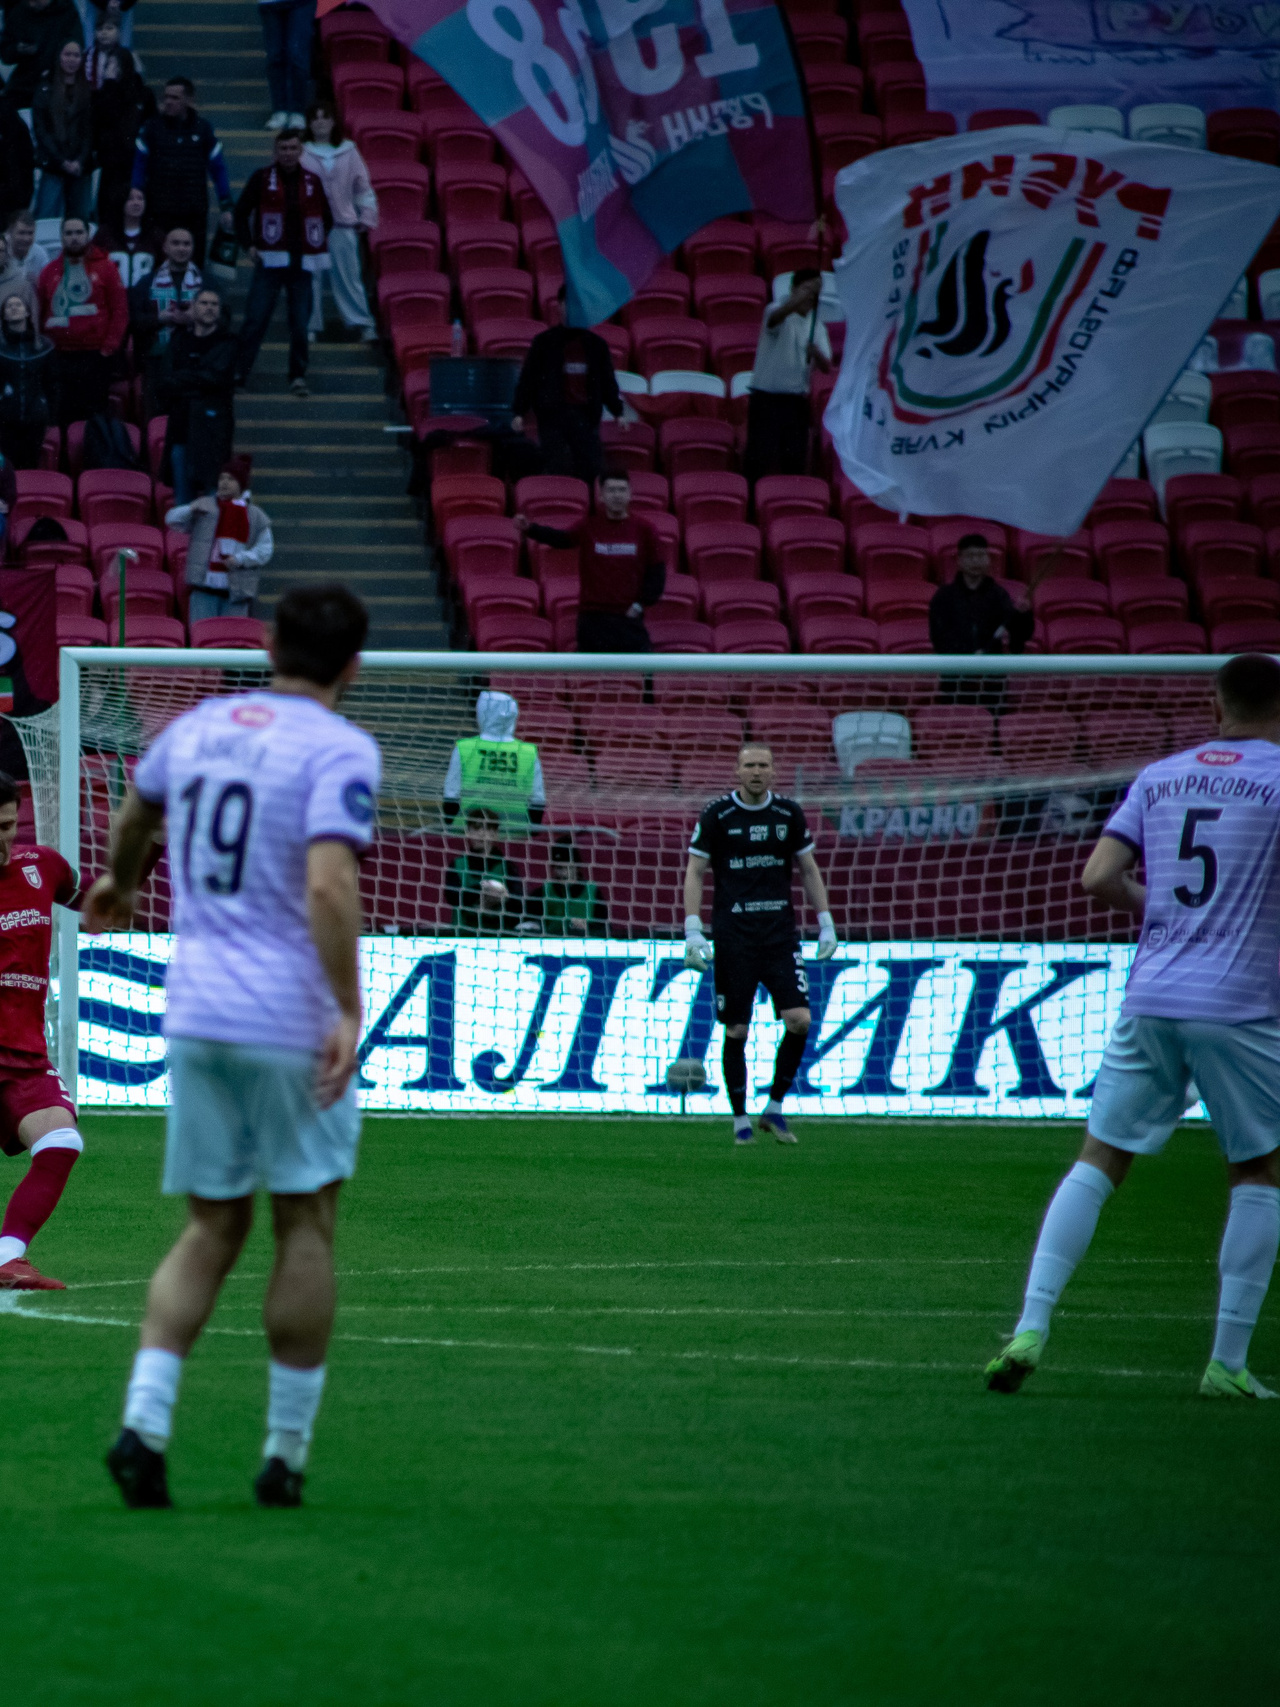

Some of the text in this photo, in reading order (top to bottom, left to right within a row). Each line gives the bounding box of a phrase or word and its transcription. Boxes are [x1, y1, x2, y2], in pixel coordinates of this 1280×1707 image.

[180, 775, 252, 894] 19
[1144, 775, 1276, 812] ДЖУРАСОВИЧ
[1174, 808, 1223, 909] 5
